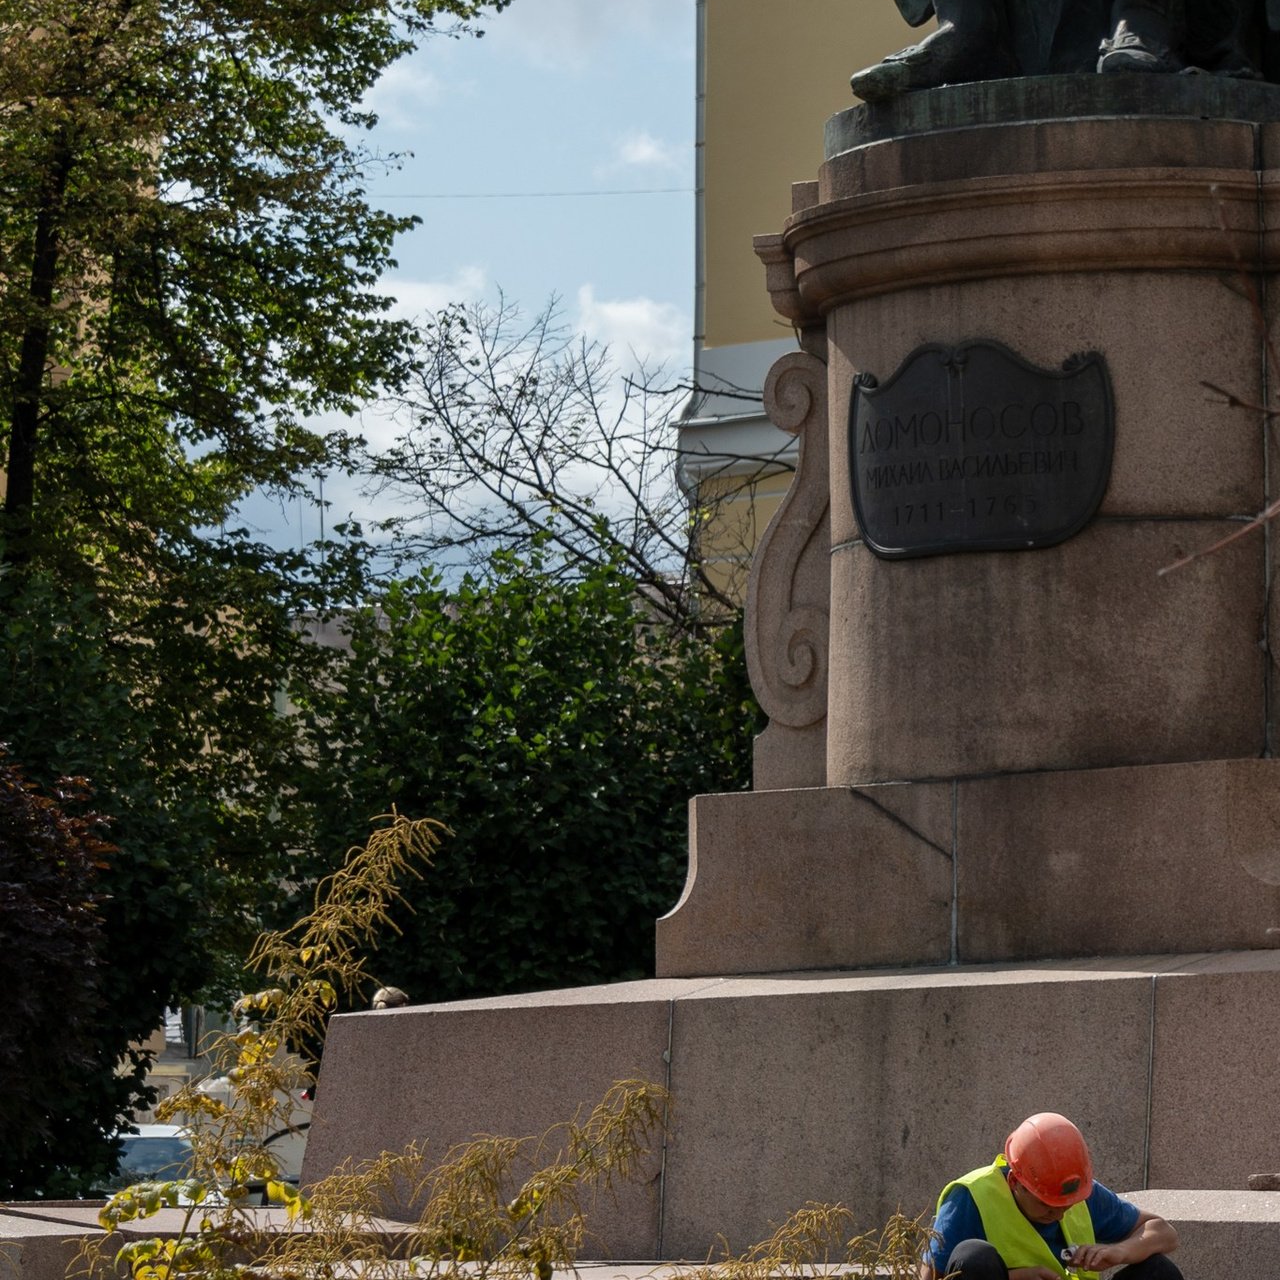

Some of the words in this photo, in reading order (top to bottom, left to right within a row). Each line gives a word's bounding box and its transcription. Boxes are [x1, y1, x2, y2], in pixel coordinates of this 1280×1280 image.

[861, 401, 1084, 453] ЛОМОНОСОВ
[867, 460, 935, 489] МИХАИЛ
[938, 451, 1078, 480] ВАСИЛЬЕВИЧ
